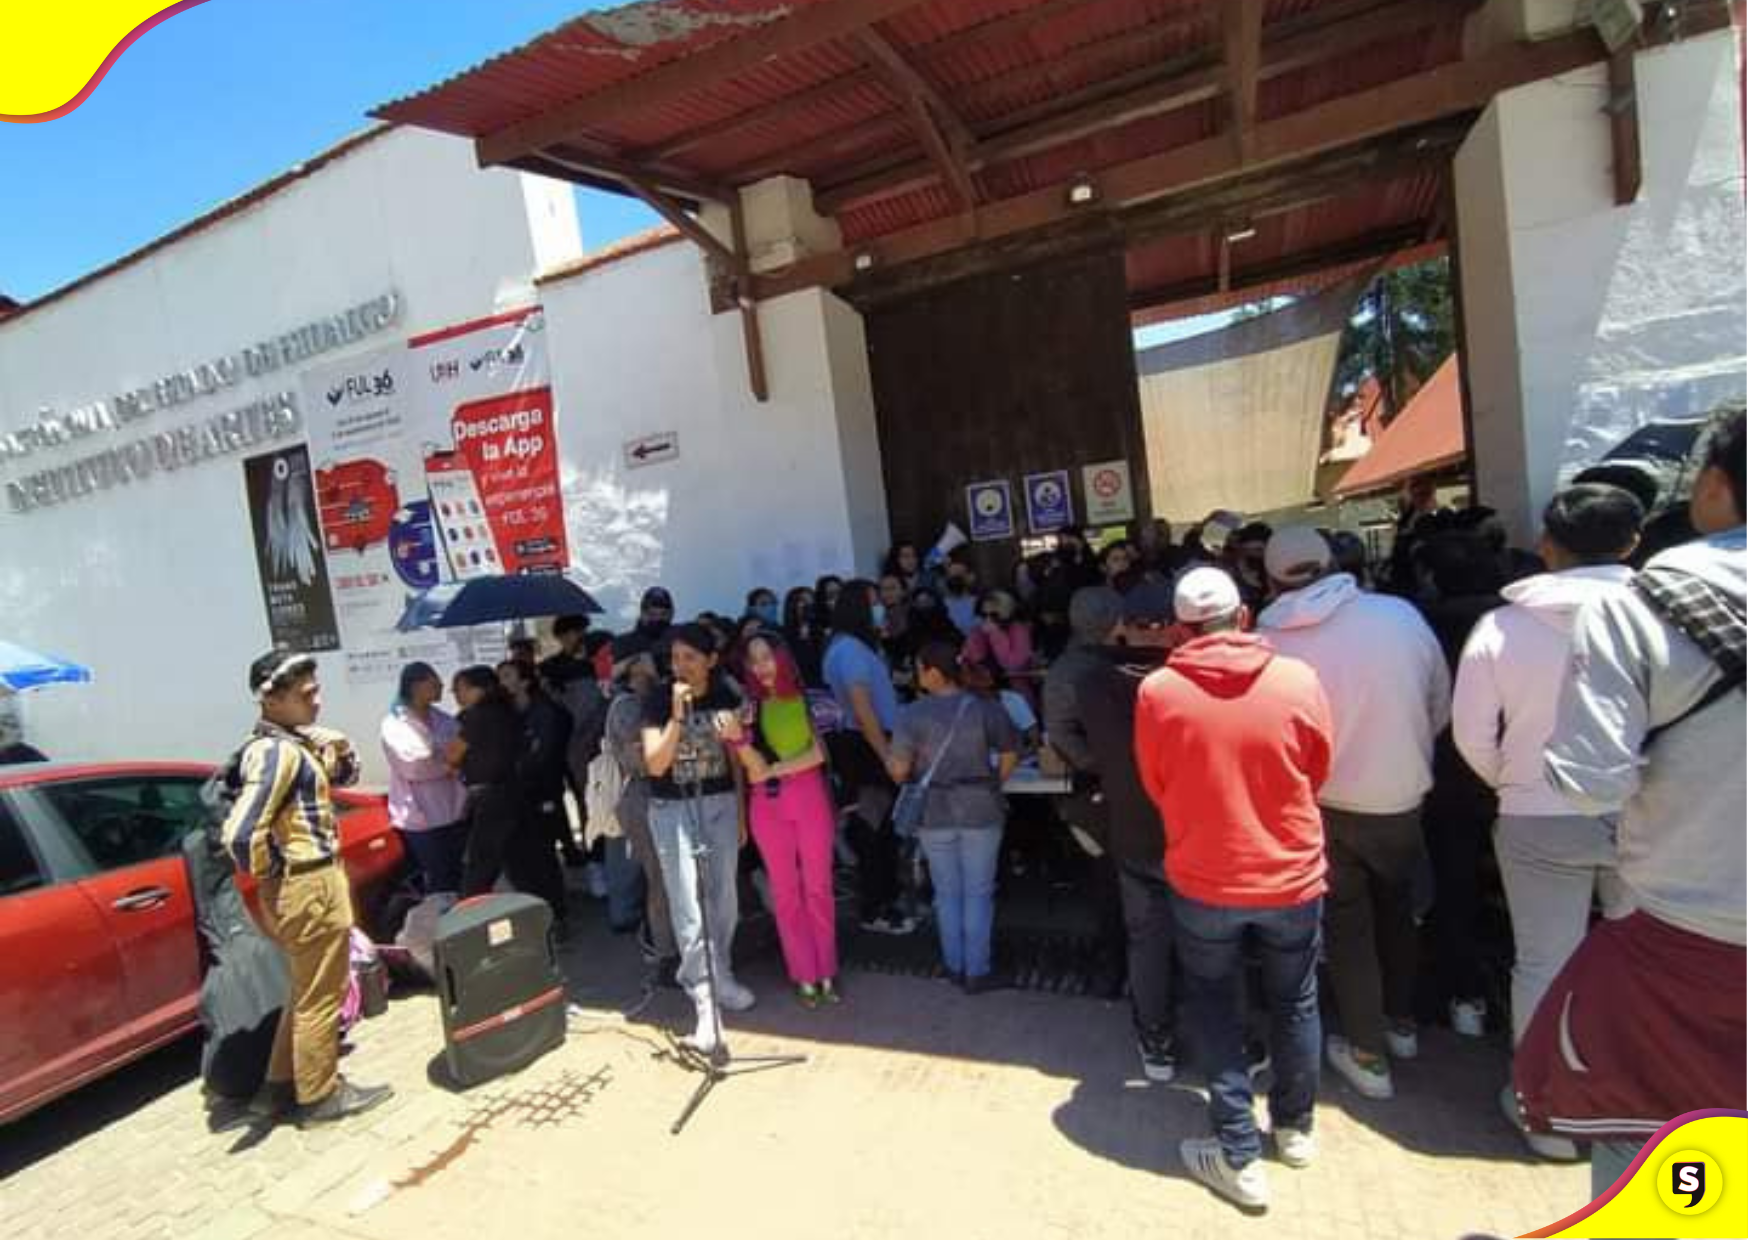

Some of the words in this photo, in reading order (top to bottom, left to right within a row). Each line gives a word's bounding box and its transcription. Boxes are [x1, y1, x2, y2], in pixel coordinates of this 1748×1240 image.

[346, 375, 373, 400] FUL
[373, 368, 395, 397] 36
[453, 408, 543, 442] Descarga
[482, 440, 501, 461] la
[503, 434, 544, 459] App
